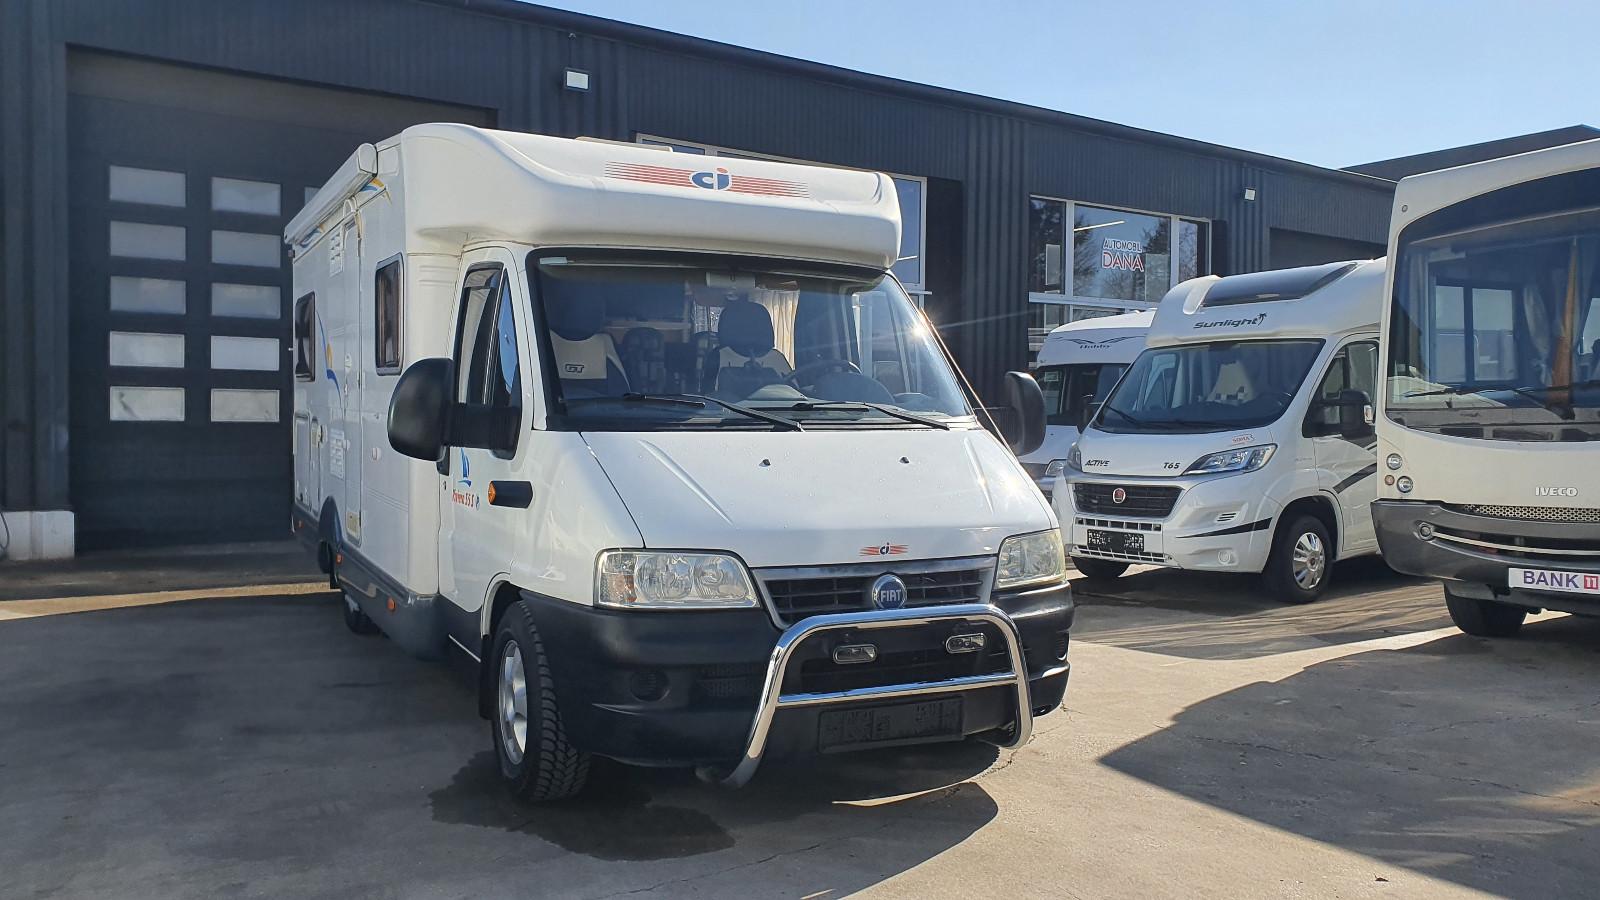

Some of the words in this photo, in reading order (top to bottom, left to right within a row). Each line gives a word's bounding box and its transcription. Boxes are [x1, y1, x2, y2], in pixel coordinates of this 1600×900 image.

[1102, 251, 1144, 272] DANA
[1085, 459, 1110, 467] ACTIVE
[1535, 486, 1579, 497] IVECO
[1523, 570, 1580, 588] BANK
[880, 589, 902, 602] FIAT
